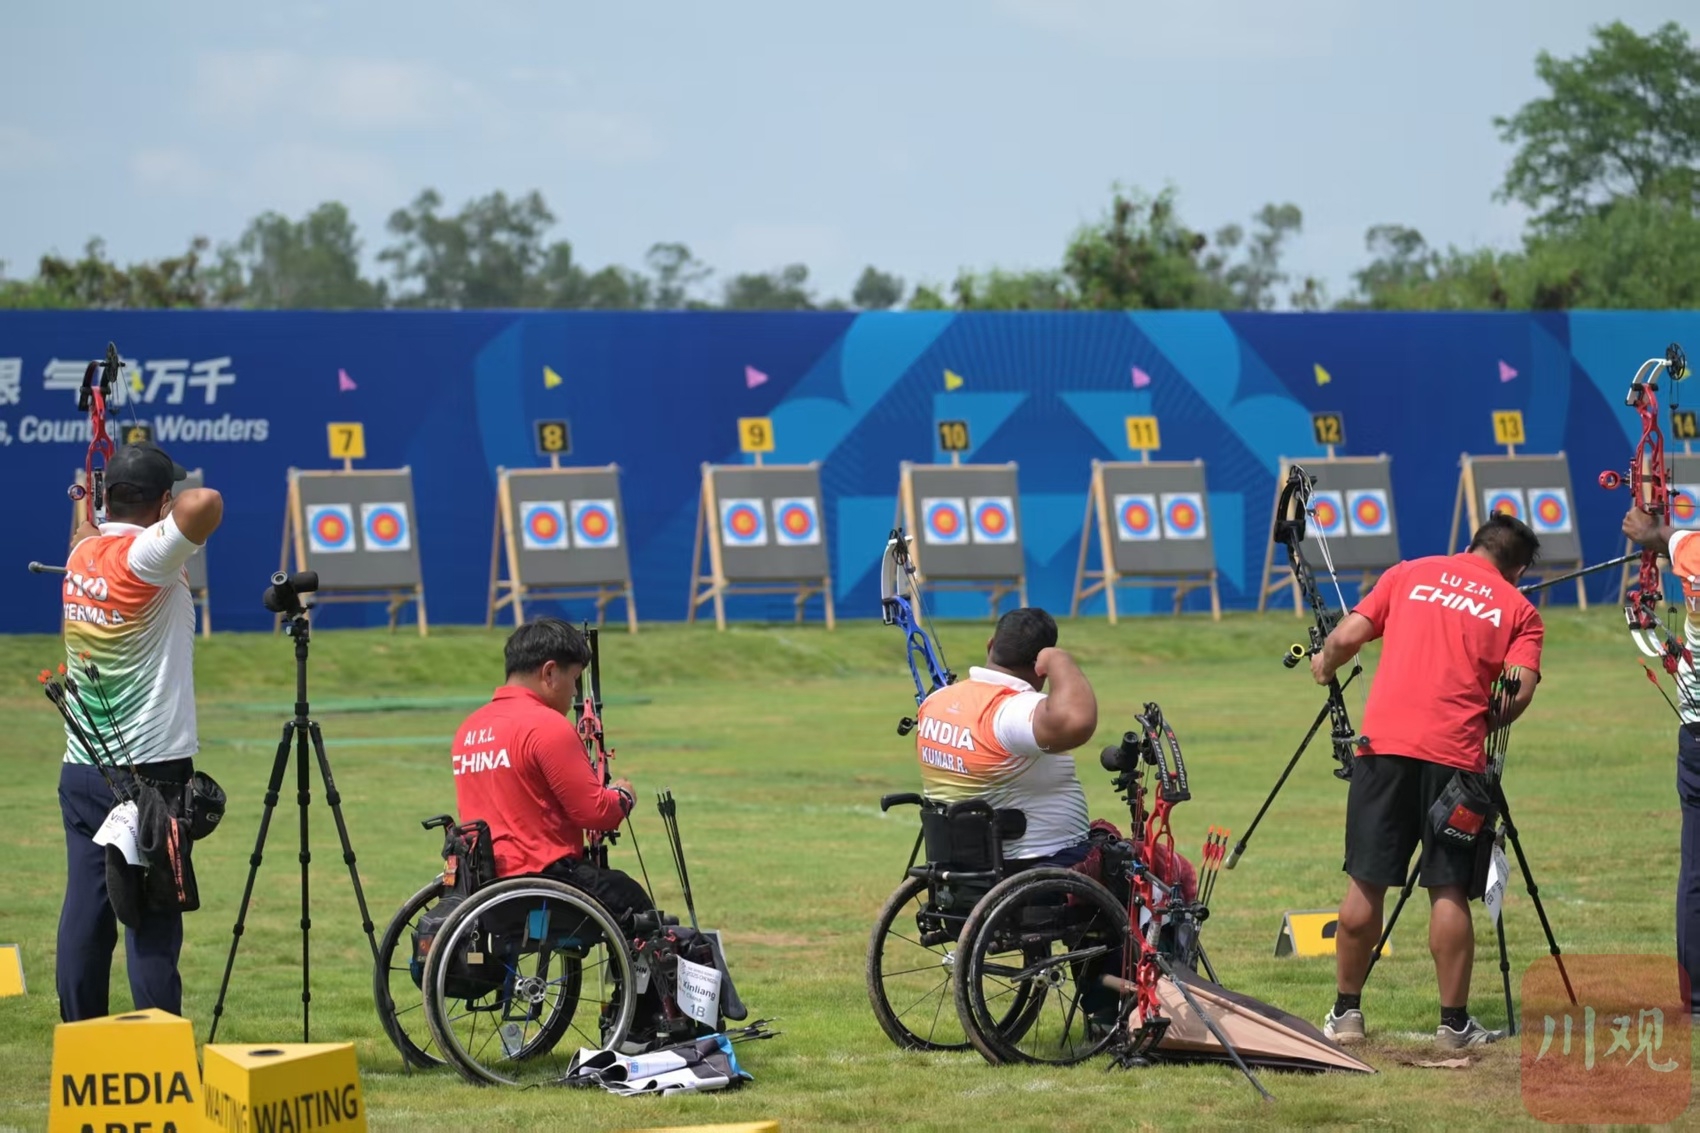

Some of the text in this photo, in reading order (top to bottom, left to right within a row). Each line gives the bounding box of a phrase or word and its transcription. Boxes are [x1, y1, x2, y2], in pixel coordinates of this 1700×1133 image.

[154, 413, 270, 442] Wonders
[542, 424, 564, 450] 8
[749, 424, 765, 447] 9
[941, 424, 967, 448] 10
[1132, 423, 1154, 445] 11
[1315, 416, 1340, 443] 12
[1500, 415, 1521, 438] 13
[1674, 413, 1695, 437] 14
[338, 429, 355, 451] 7
[1440, 571, 1494, 600] LU Z.H.
[1408, 584, 1502, 628] CHINA
[463, 727, 495, 747] AI X.L.
[920, 716, 975, 751] INDIA
[452, 748, 511, 775] CHINA
[1443, 827, 1475, 841] CHN
[683, 980, 716, 1002] Xinliang
[690, 1003, 706, 1018] 1B
[62, 1071, 194, 1107] MEDIA
[204, 1082, 248, 1133] WAITING
[253, 1083, 359, 1133] WAITING
